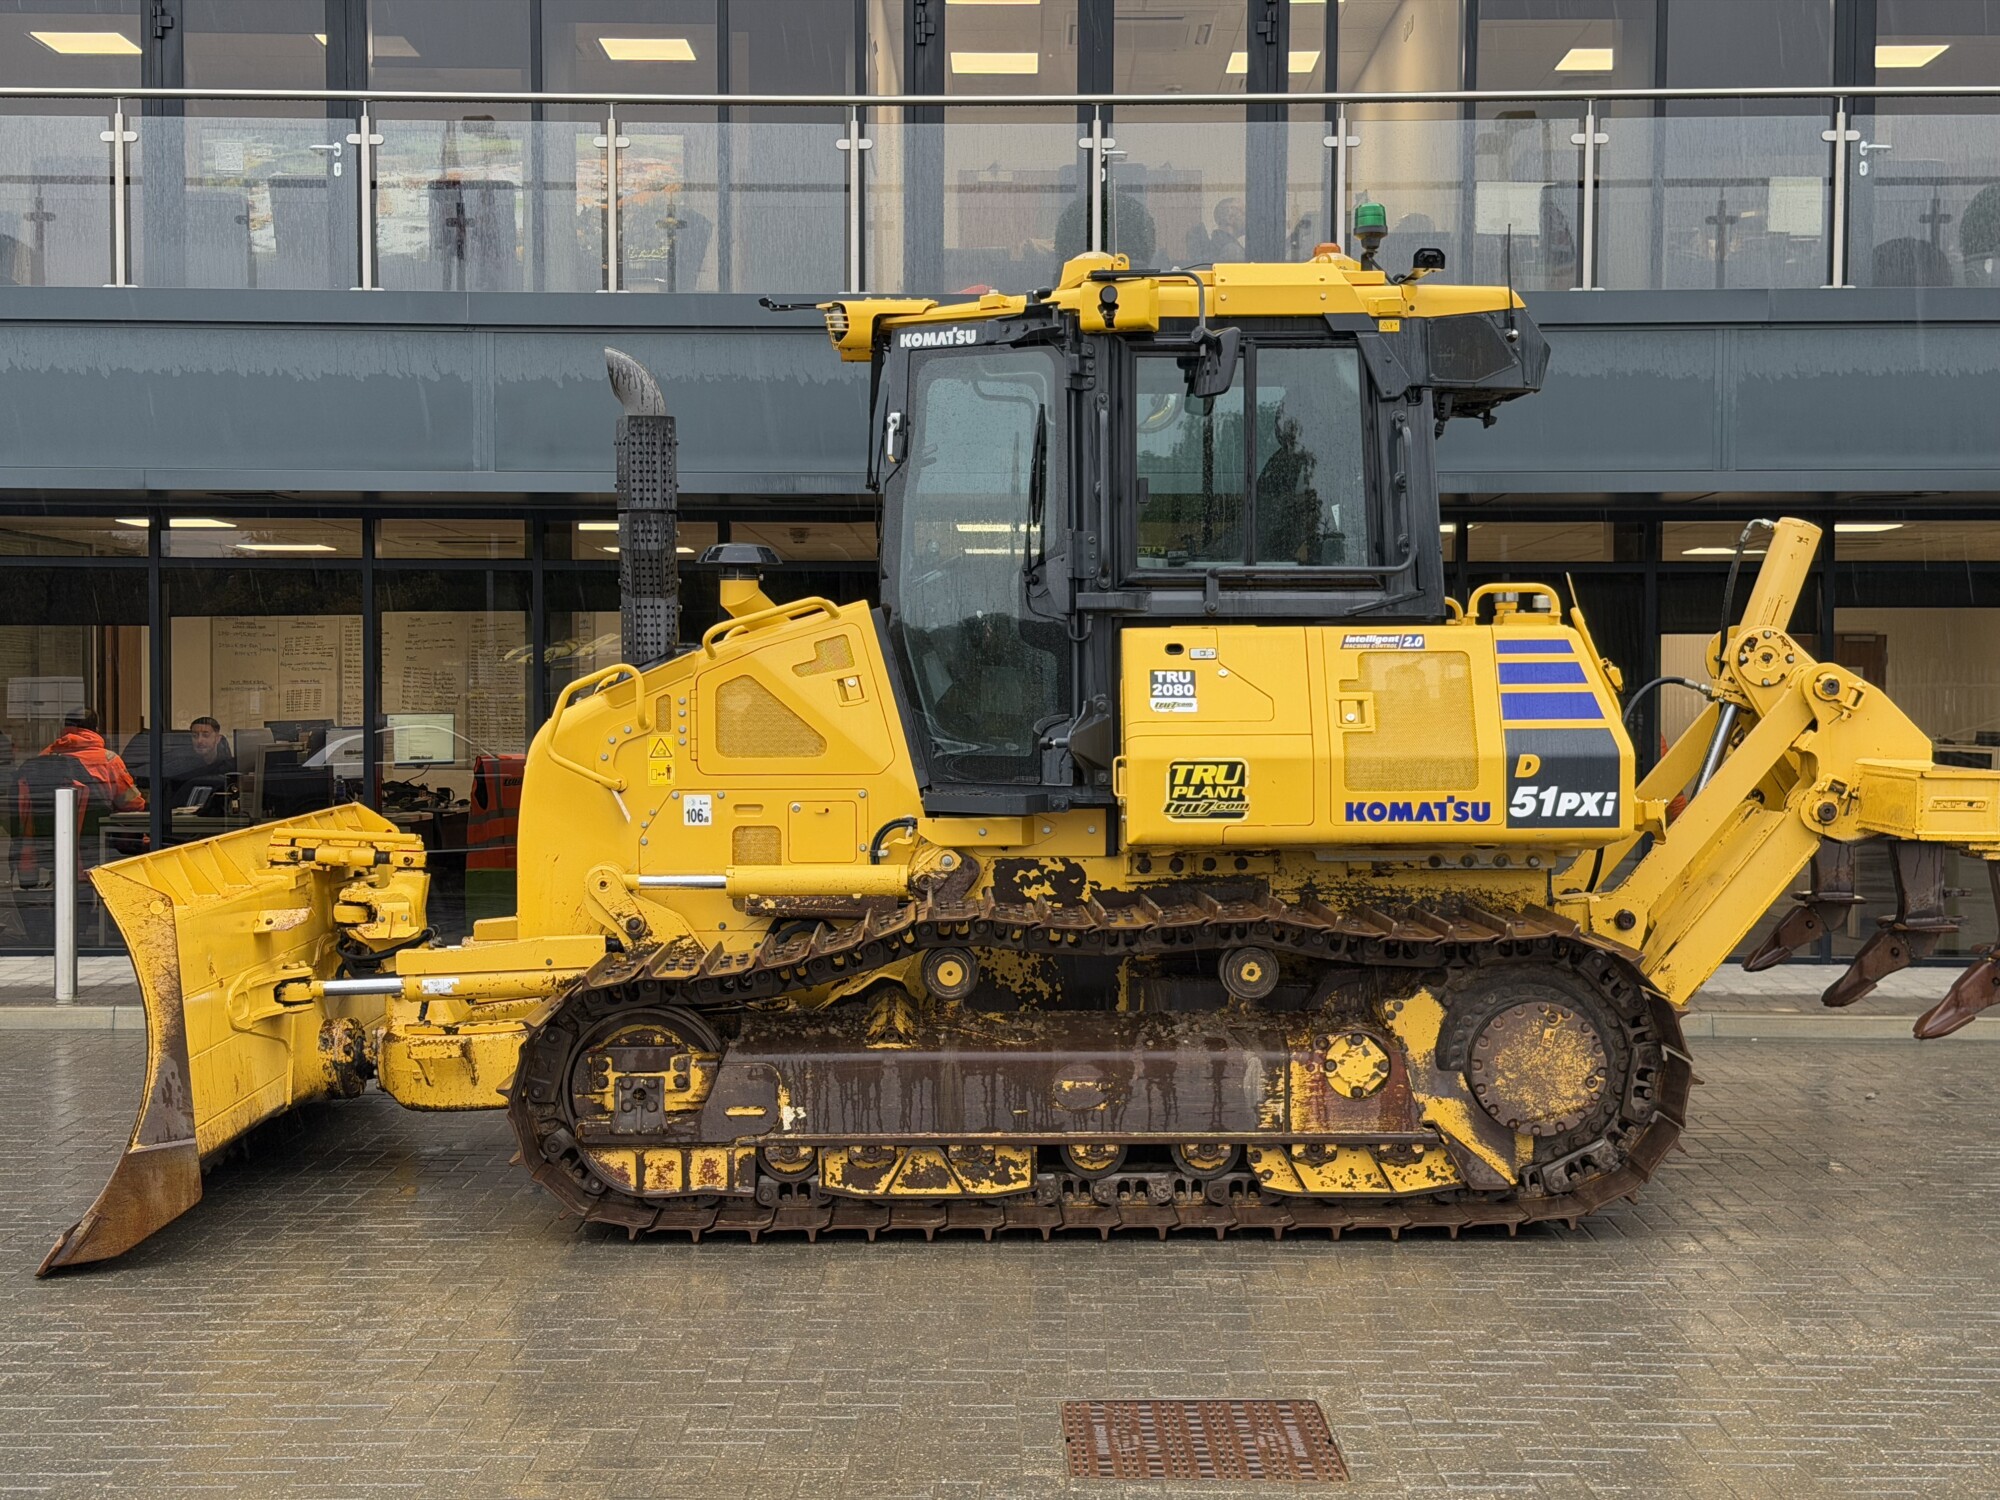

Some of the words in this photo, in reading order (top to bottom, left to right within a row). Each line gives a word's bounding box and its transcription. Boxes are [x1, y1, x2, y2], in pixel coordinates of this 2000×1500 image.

[900, 326, 977, 347] KOMATSU
[1403, 636, 1423, 647] 2.0
[1154, 671, 1191, 683] TRU
[1152, 683, 1194, 696] 2080
[1515, 754, 1541, 778] D
[1171, 765, 1243, 785] TRU
[1171, 786, 1243, 798] PLANT
[1163, 801, 1249, 814] tru7.com
[1345, 796, 1491, 822] KOMATSU
[1509, 786, 1617, 818] 51PXi
[686, 808, 704, 823] 106
